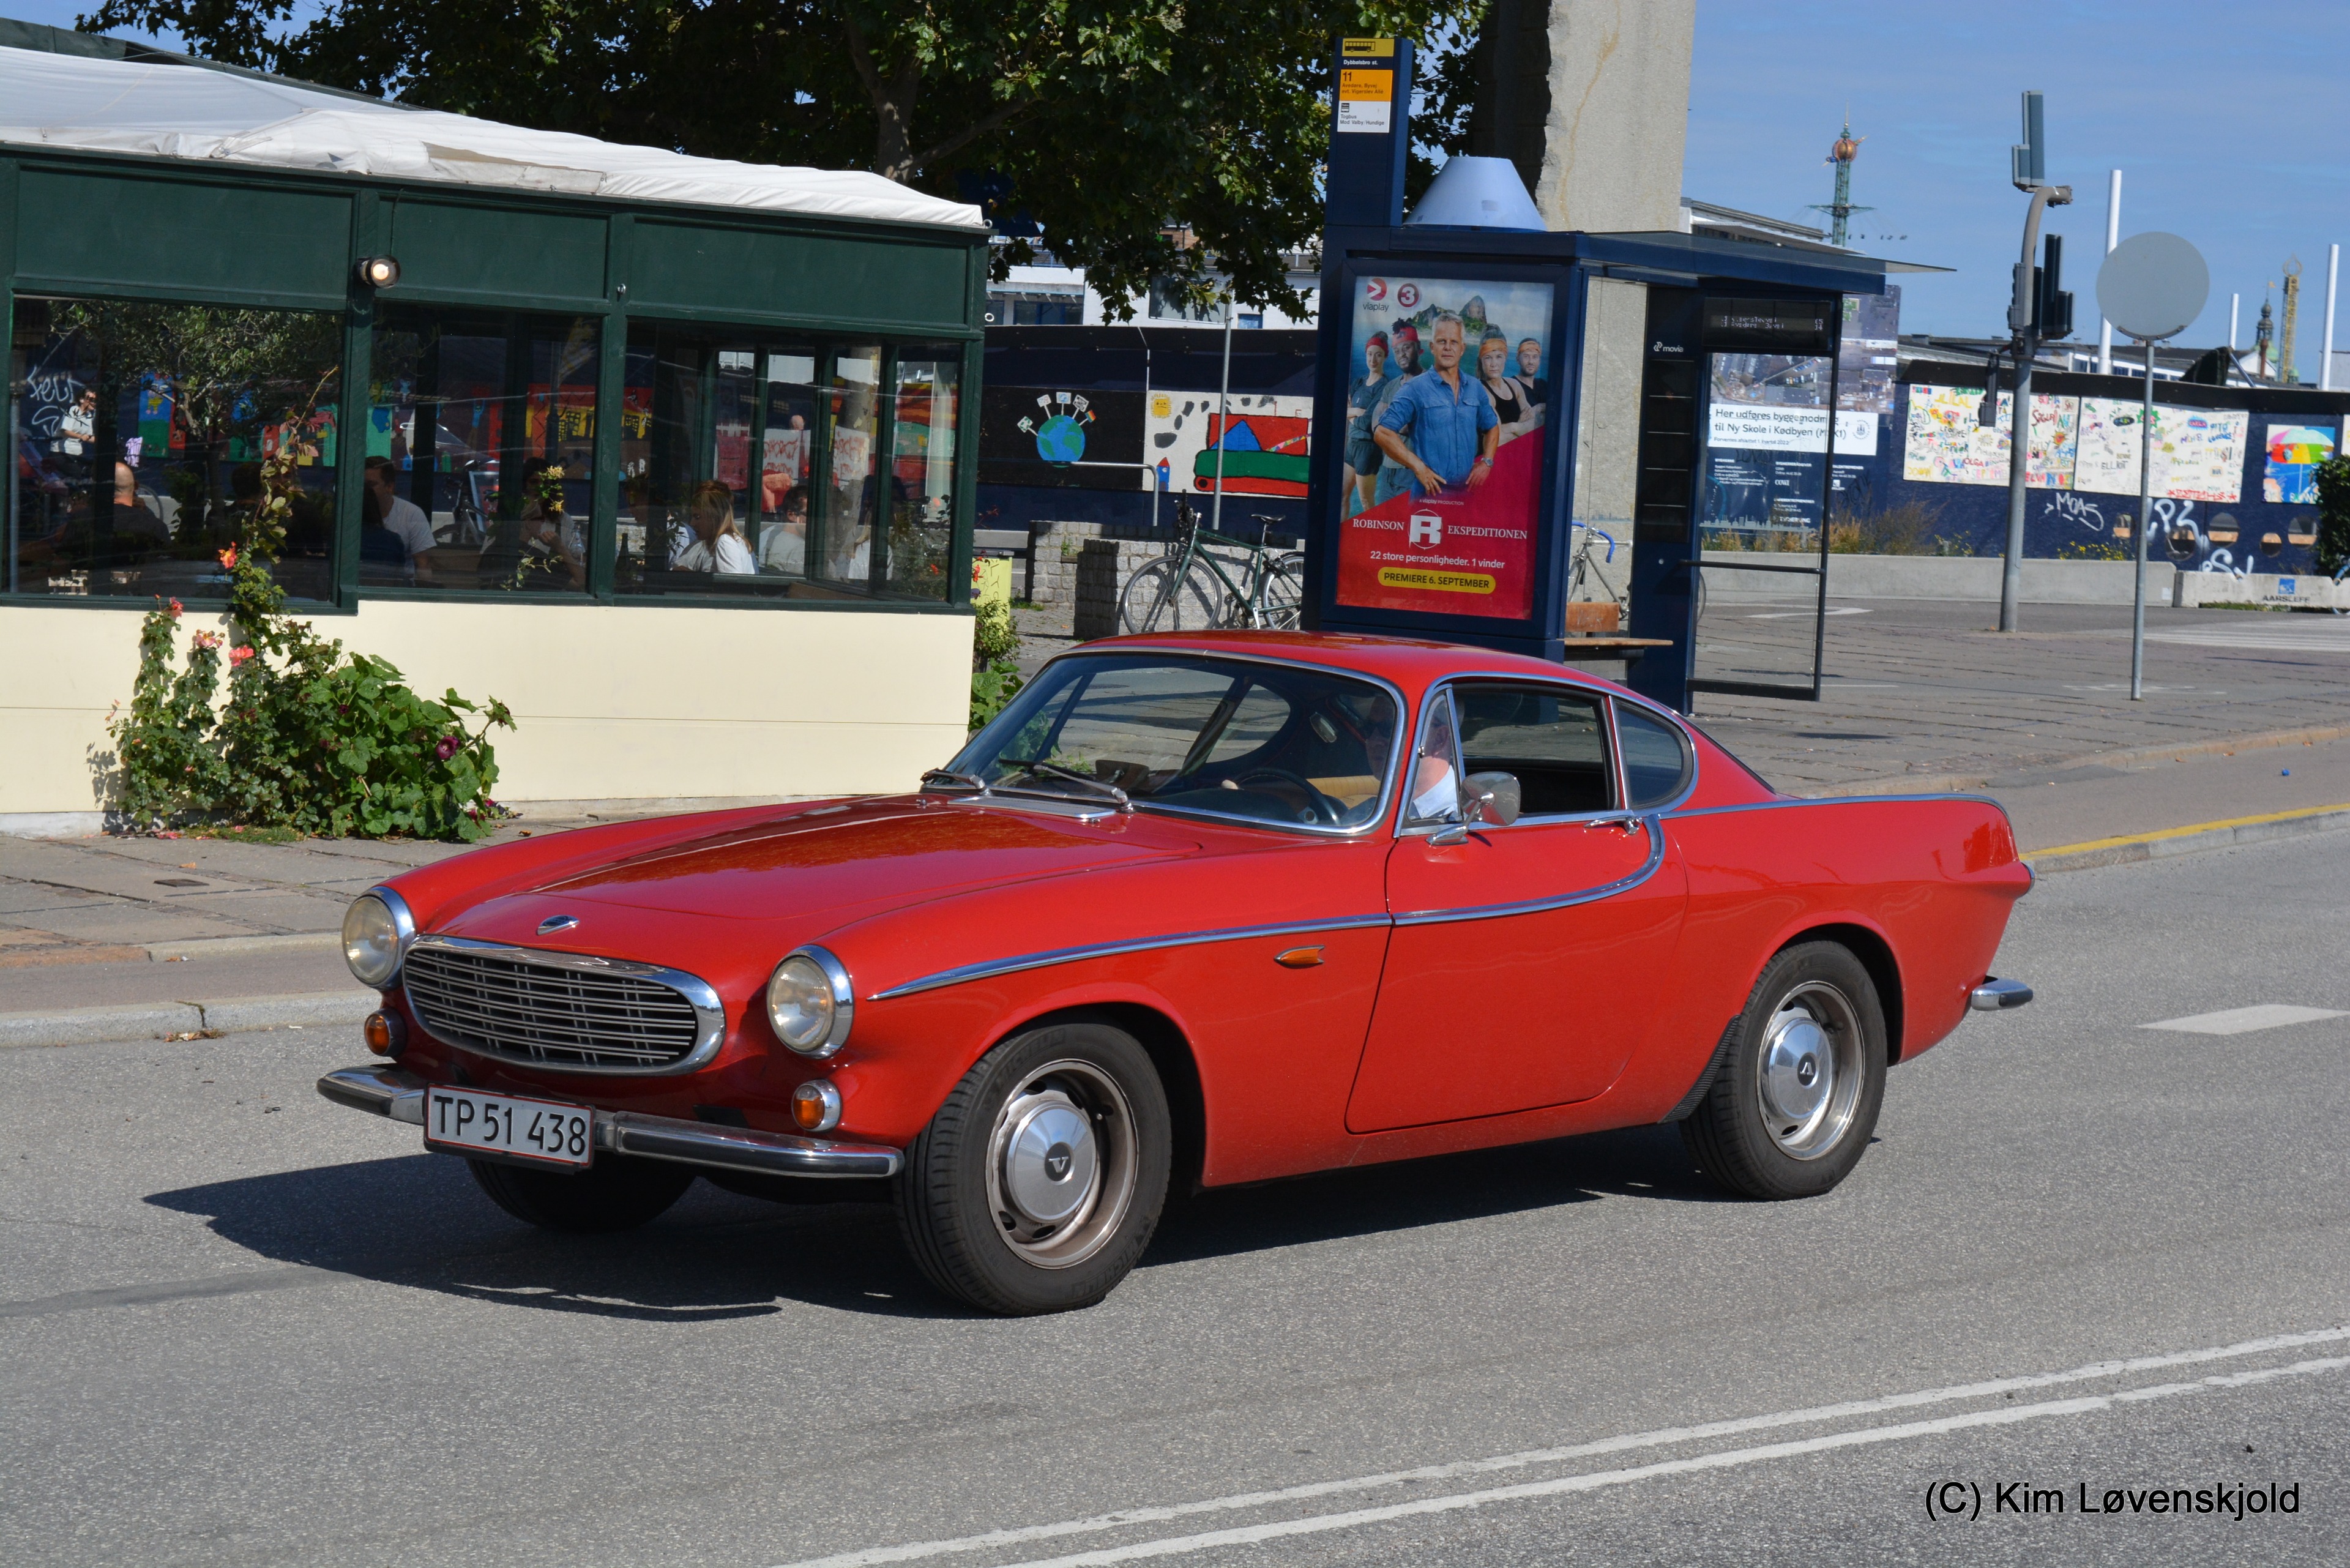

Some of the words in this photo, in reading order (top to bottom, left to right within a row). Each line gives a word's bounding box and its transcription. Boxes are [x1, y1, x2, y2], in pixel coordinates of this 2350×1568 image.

[1343, 71, 1352, 81] 11
[1362, 302, 1389, 312] viaplay
[1715, 408, 1734, 418] Her
[1736, 410, 1771, 421] udføres
[1727, 423, 1740, 434] Ny
[1743, 424, 1767, 433] Skole
[1774, 426, 1813, 438] Kødbyen
[1963, 458, 1984, 466] OLGA
[1352, 518, 1405, 531] ROBINSON
[1409, 515, 1442, 546] R
[1447, 525, 1528, 539] EKSPEDITIONEN
[1370, 551, 1381, 559] 22
[1382, 552, 1404, 561] store
[1406, 553, 1469, 566] personligheder.
[1472, 558, 1476, 567] 1
[1478, 559, 1505, 569] vinder
[1384, 572, 1428, 583] PREMIERE
[1428, 576, 1436, 584] 6.
[1438, 577, 1490, 588] SEPTEMBER
[433, 1095, 475, 1137] TP
[483, 1103, 513, 1145] 51
[528, 1111, 586, 1157] 438
[1048, 1156, 1069, 1173] V
